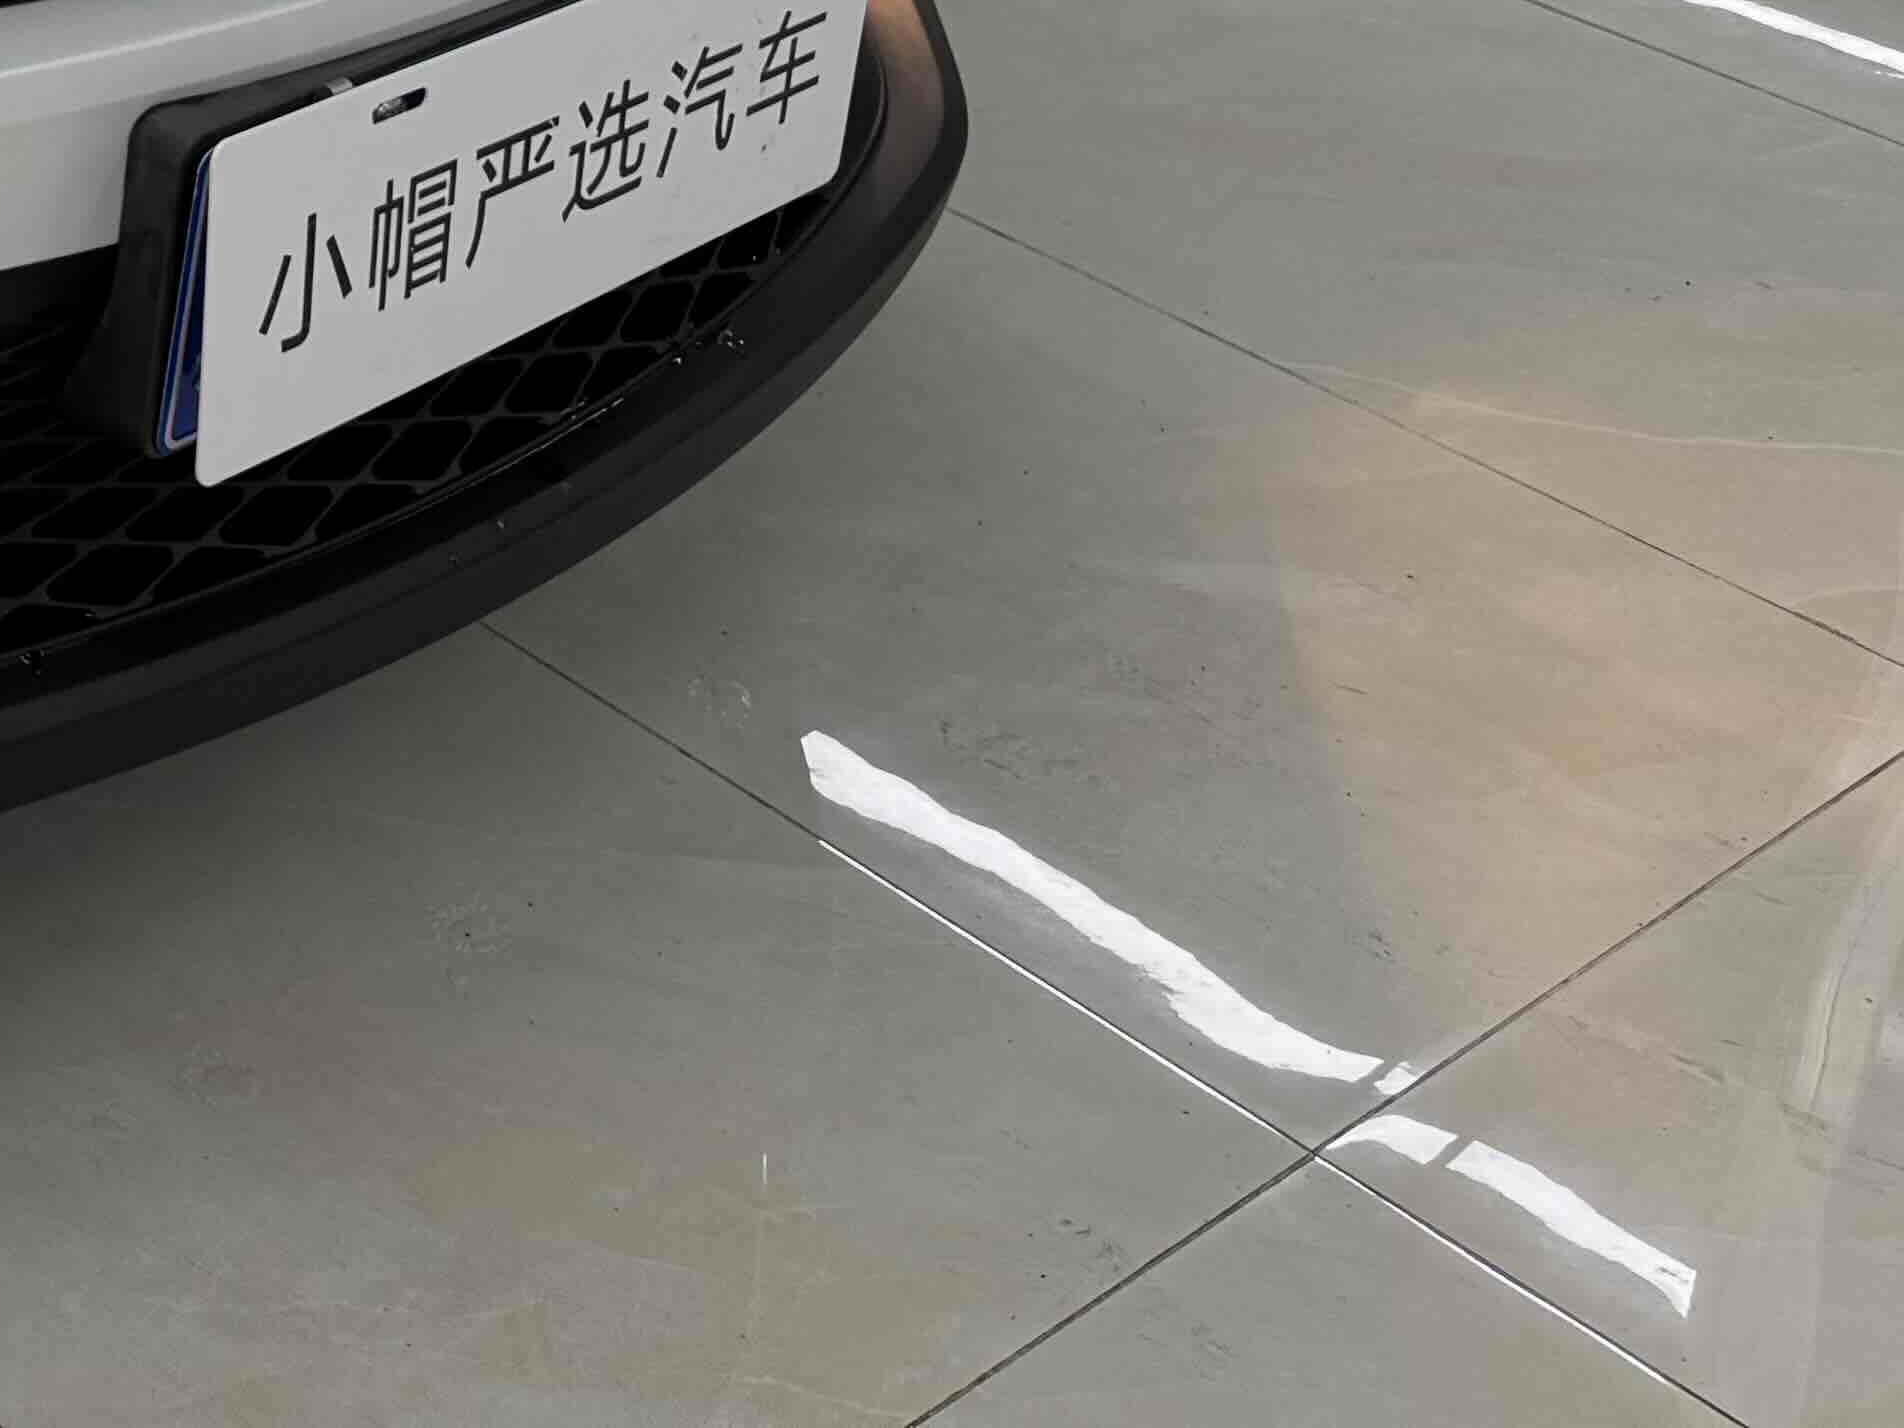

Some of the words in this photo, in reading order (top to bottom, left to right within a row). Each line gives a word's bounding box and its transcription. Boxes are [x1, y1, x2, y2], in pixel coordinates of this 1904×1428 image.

[259, 10, 828, 353] 小帽严选汽车
